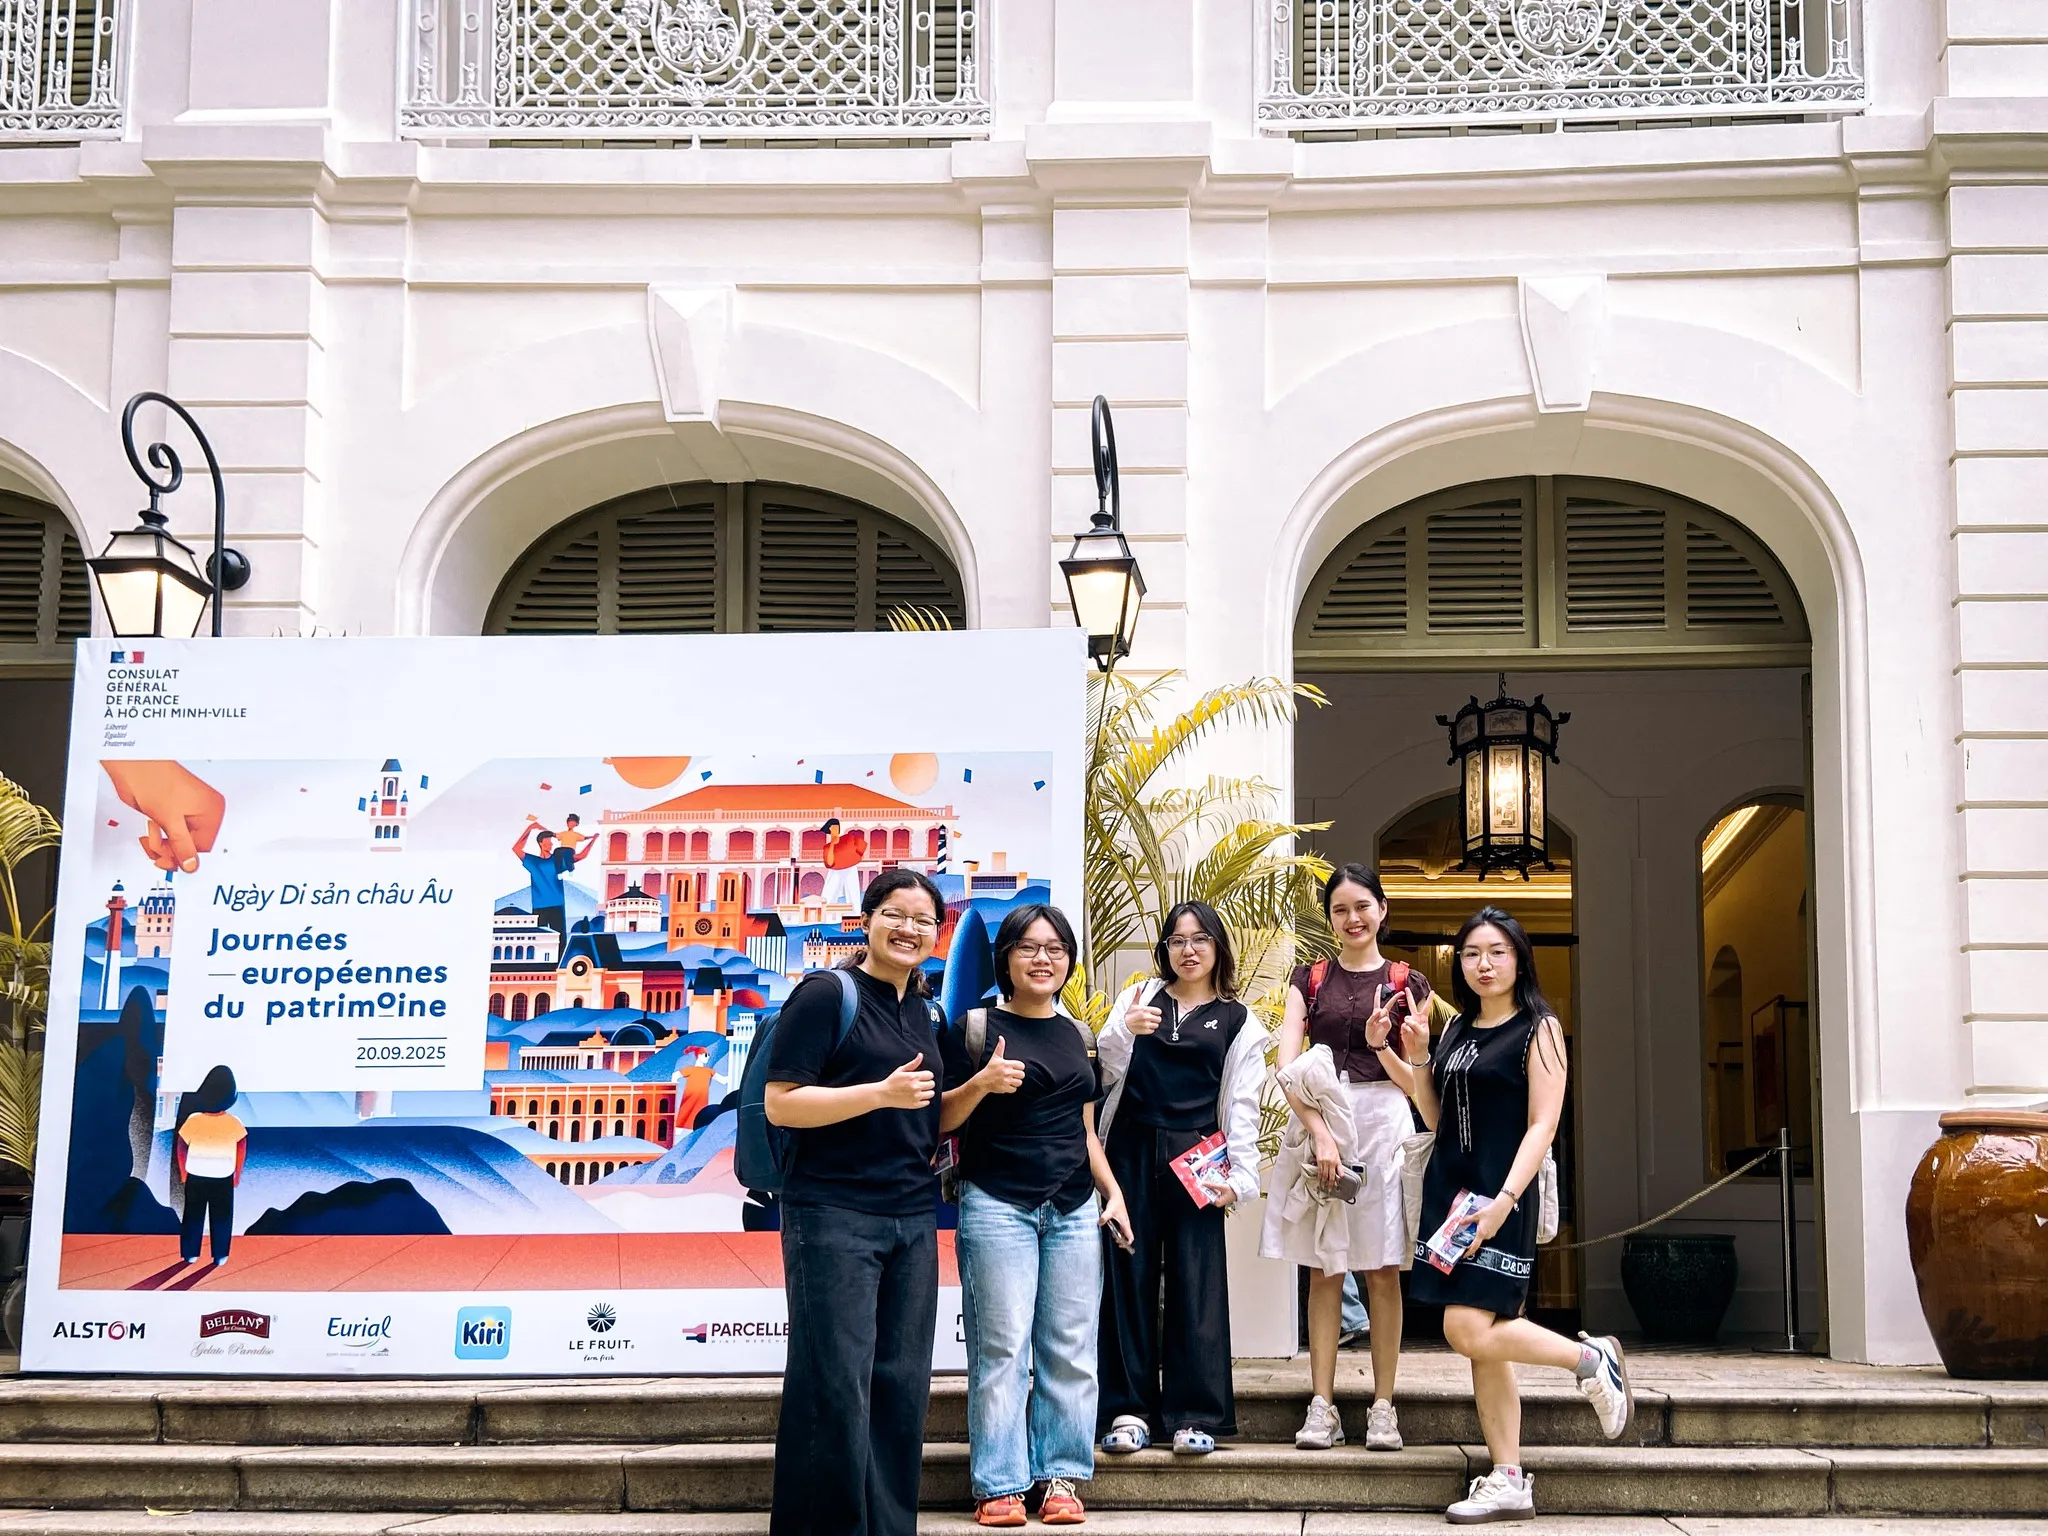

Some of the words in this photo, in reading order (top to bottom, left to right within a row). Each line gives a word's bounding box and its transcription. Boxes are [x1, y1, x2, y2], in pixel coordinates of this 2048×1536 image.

[107, 669, 180, 680] CONSULAT
[106, 680, 168, 692] GÉNÉRAL
[105, 695, 123, 705] DE
[127, 695, 179, 706] FRANCE
[104, 706, 114, 718] À
[142, 708, 166, 718] CHI
[171, 708, 248, 718] MINH-VILLE
[213, 883, 275, 912] Ngày
[280, 883, 308, 905] Di
[311, 882, 350, 905] sản
[357, 883, 414, 905] châu
[419, 878, 453, 905] Âu
[207, 926, 348, 956] Journées
[242, 960, 448, 991] européennes
[204, 994, 245, 1018] du
[266, 992, 447, 1025] patrimoine
[356, 1046, 446, 1060] 20.09.2025
[53, 1321, 146, 1340] ALSTOM
[205, 1315, 264, 1330] BELLANY
[327, 1315, 392, 1339] Eurial
[463, 1321, 504, 1345] Kiri
[569, 1340, 584, 1350] LE
[589, 1339, 632, 1350] FRUIT
